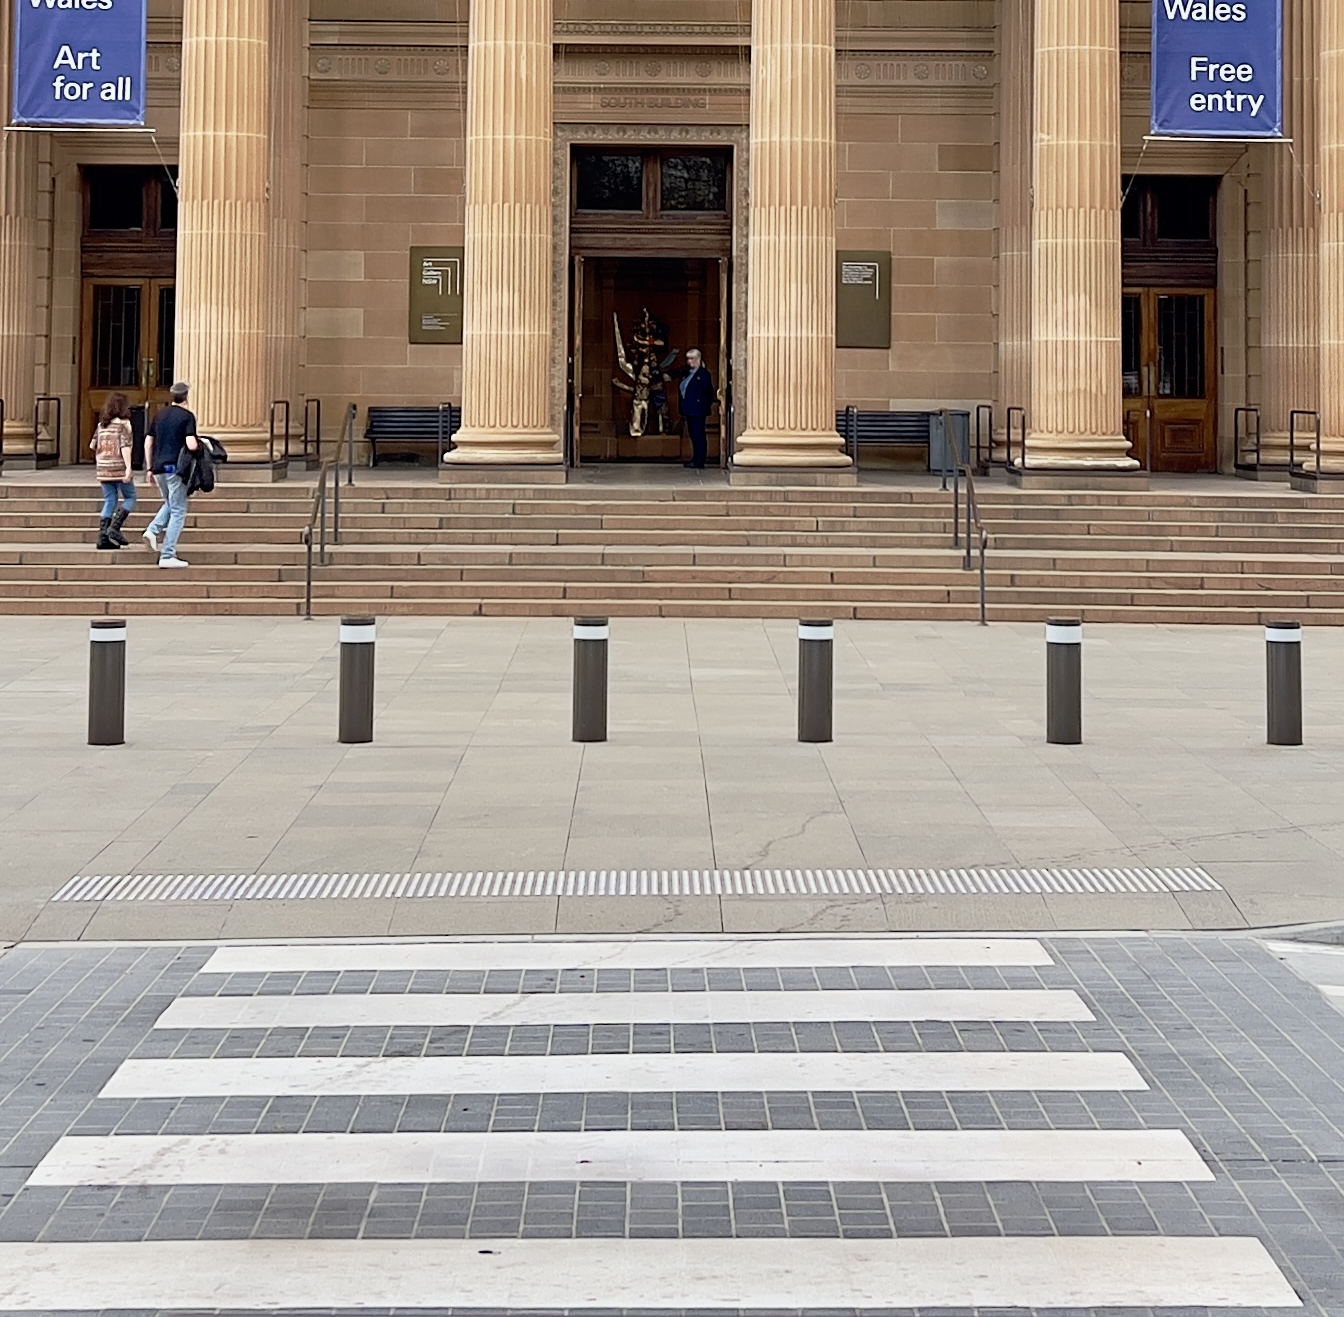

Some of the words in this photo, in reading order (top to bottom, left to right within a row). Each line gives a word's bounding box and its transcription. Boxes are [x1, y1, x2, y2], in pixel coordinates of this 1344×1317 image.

[53, 45, 101, 71] Art
[1189, 57, 1254, 83] Free
[53, 75, 94, 102] for
[99, 76, 132, 102] all
[599, 97, 646, 109] SOUTH
[647, 97, 707, 110] BUILDING
[1189, 89, 1265, 118] entry
